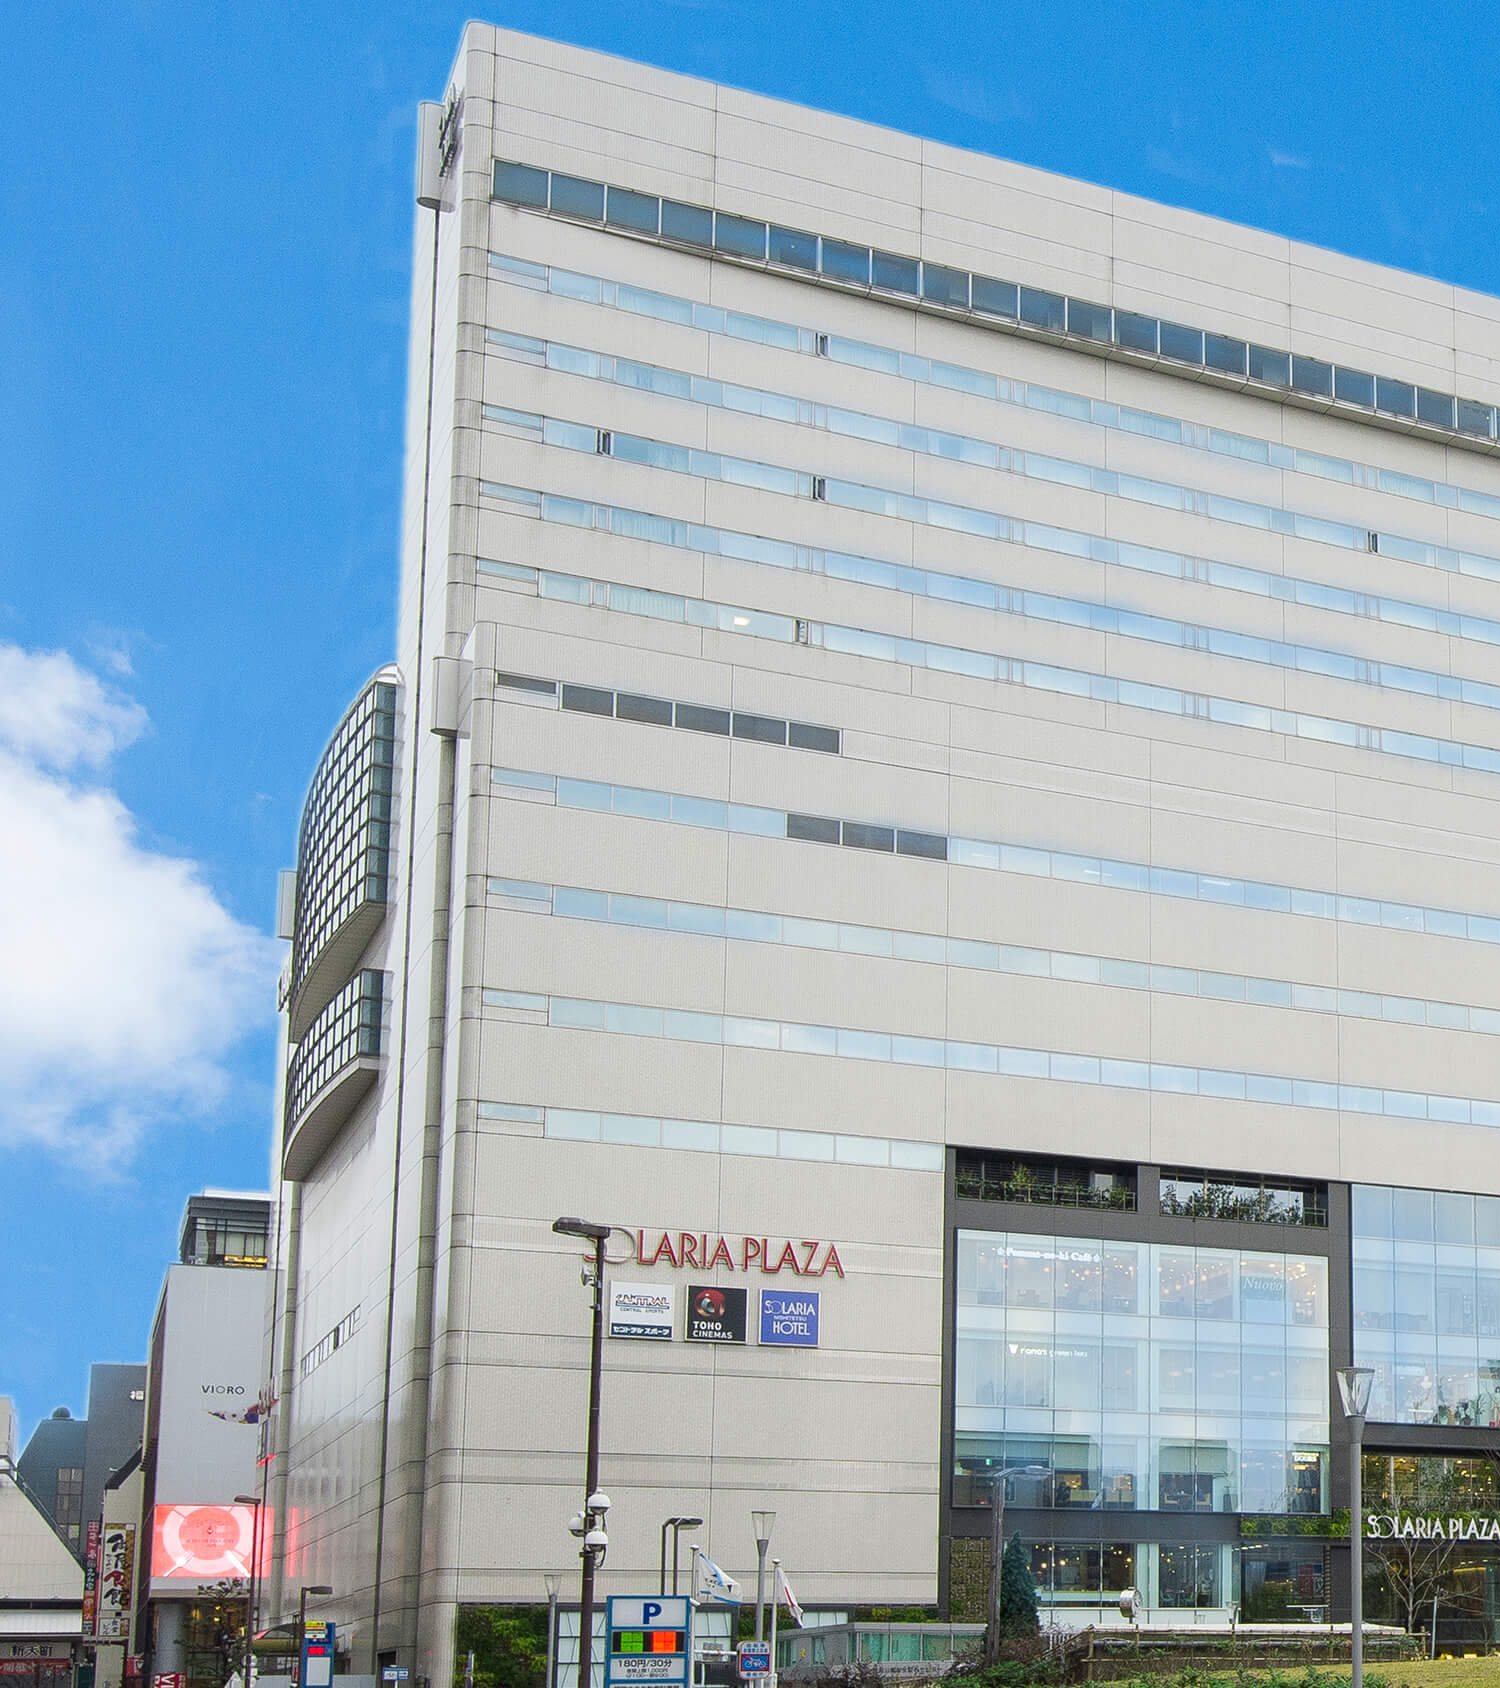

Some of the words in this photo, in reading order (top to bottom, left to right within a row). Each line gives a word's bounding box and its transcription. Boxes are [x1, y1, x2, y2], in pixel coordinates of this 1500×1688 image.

[583, 1226, 735, 1272] OLARIA
[743, 1236, 845, 1278] PLAZA
[764, 1299, 816, 1316] SOLARIA
[692, 1320, 722, 1331] TOHO
[773, 1320, 811, 1336] HOTEL
[692, 1330, 733, 1340] CINEMAS
[202, 1385, 245, 1395] VIORO
[1367, 1514, 1446, 1539] SOLARIA
[643, 1602, 662, 1625] P
[618, 1659, 672, 1668] 180円/30分
